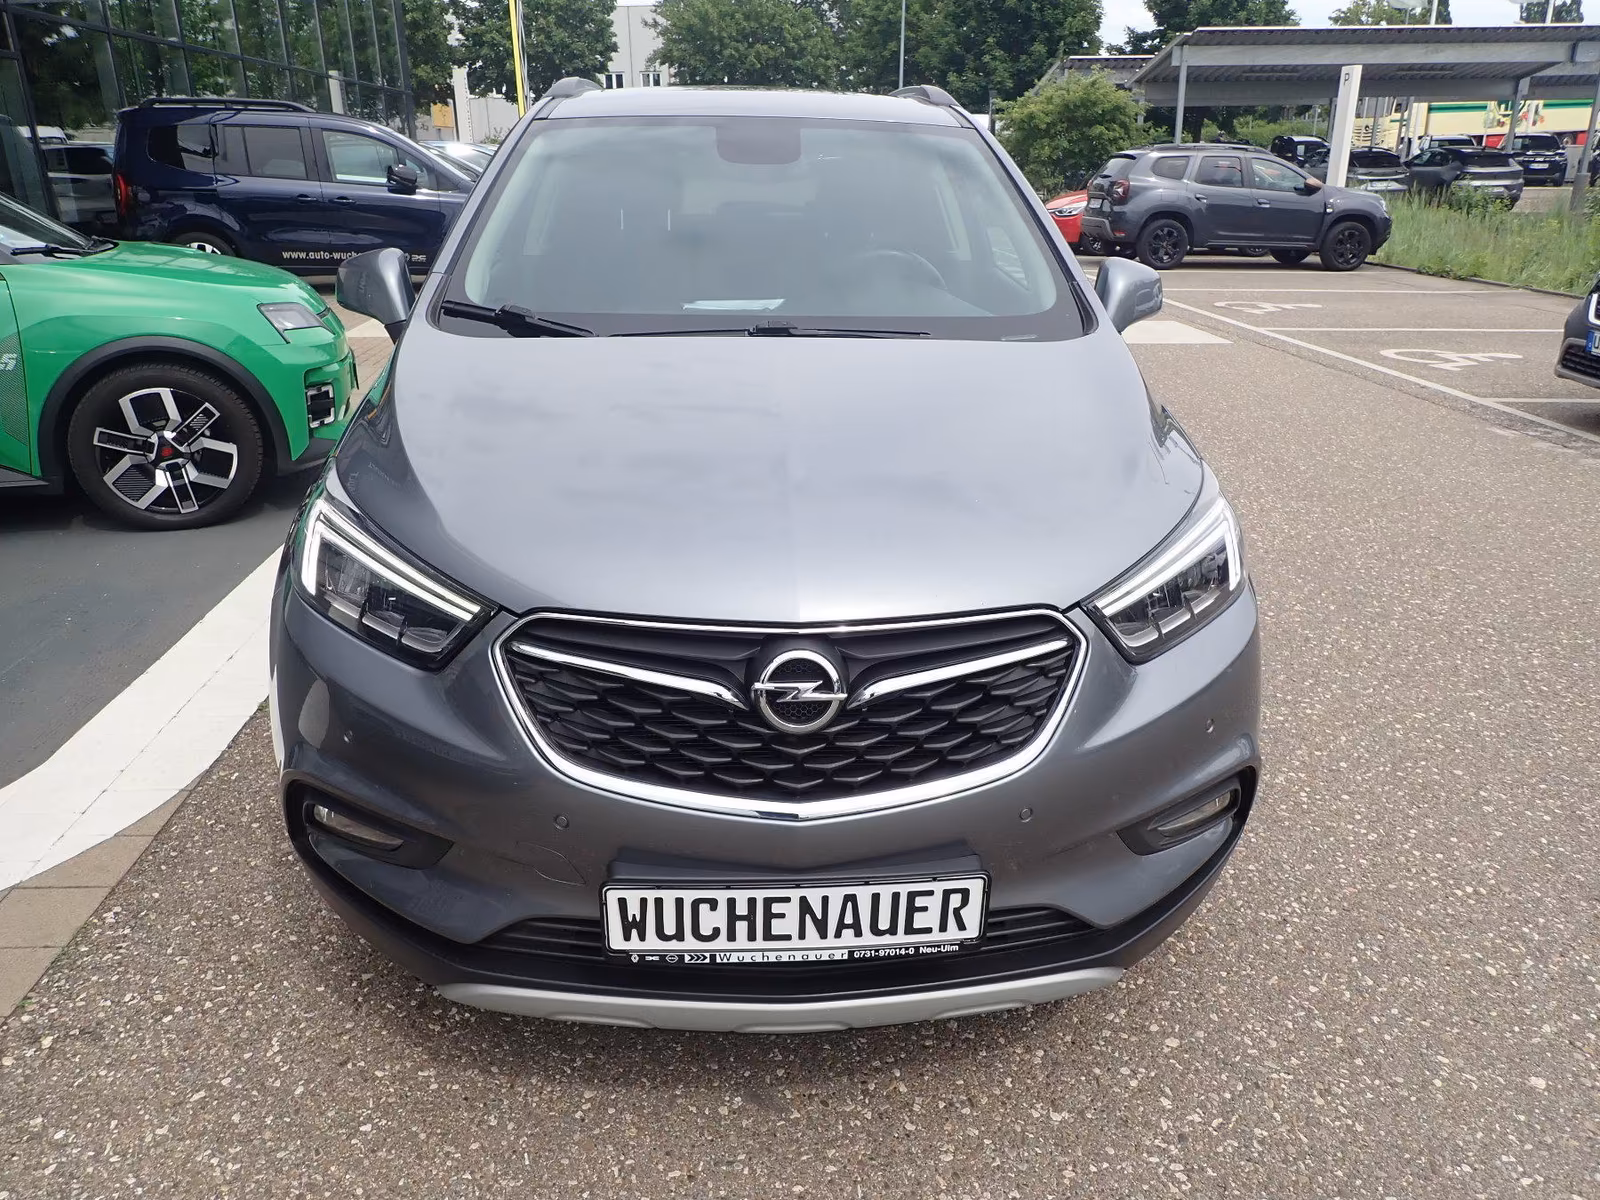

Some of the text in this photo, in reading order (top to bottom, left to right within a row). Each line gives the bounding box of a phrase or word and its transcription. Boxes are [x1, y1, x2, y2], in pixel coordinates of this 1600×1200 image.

[1343, 72, 1350, 86] P
[617, 887, 971, 943] WUCHENAUER
[718, 944, 959, 963] Wuchenauer 0731-97014-0 Neu-Ulm
